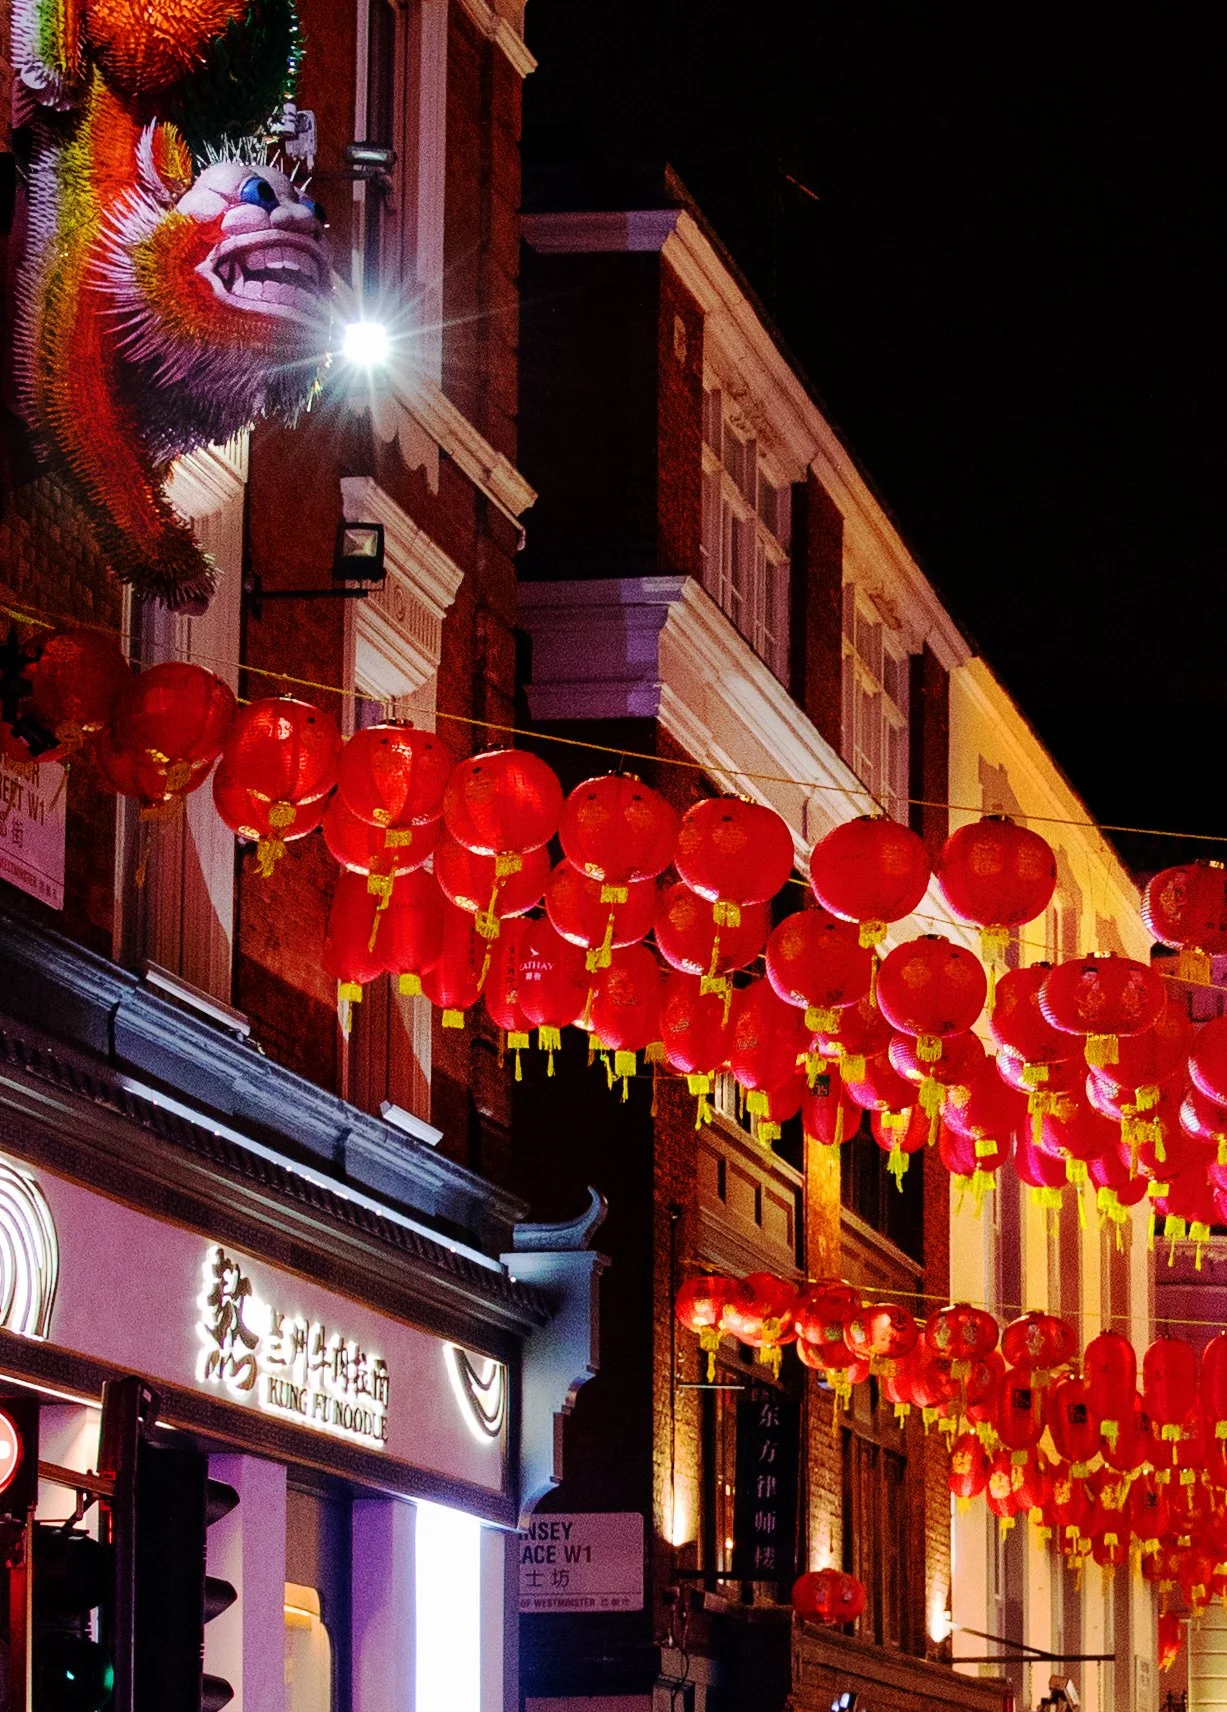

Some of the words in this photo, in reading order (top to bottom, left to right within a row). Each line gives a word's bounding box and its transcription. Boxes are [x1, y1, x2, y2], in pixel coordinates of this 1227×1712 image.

[267, 1376, 307, 1416] KUNG
[312, 1392, 330, 1422] FU
[333, 1402, 389, 1441] NOODLE
[519, 1521, 573, 1541] NSEY
[522, 1544, 556, 1565] ACE
[564, 1545, 591, 1564] W1
[534, 1597, 595, 1608] WESTMINSTER
